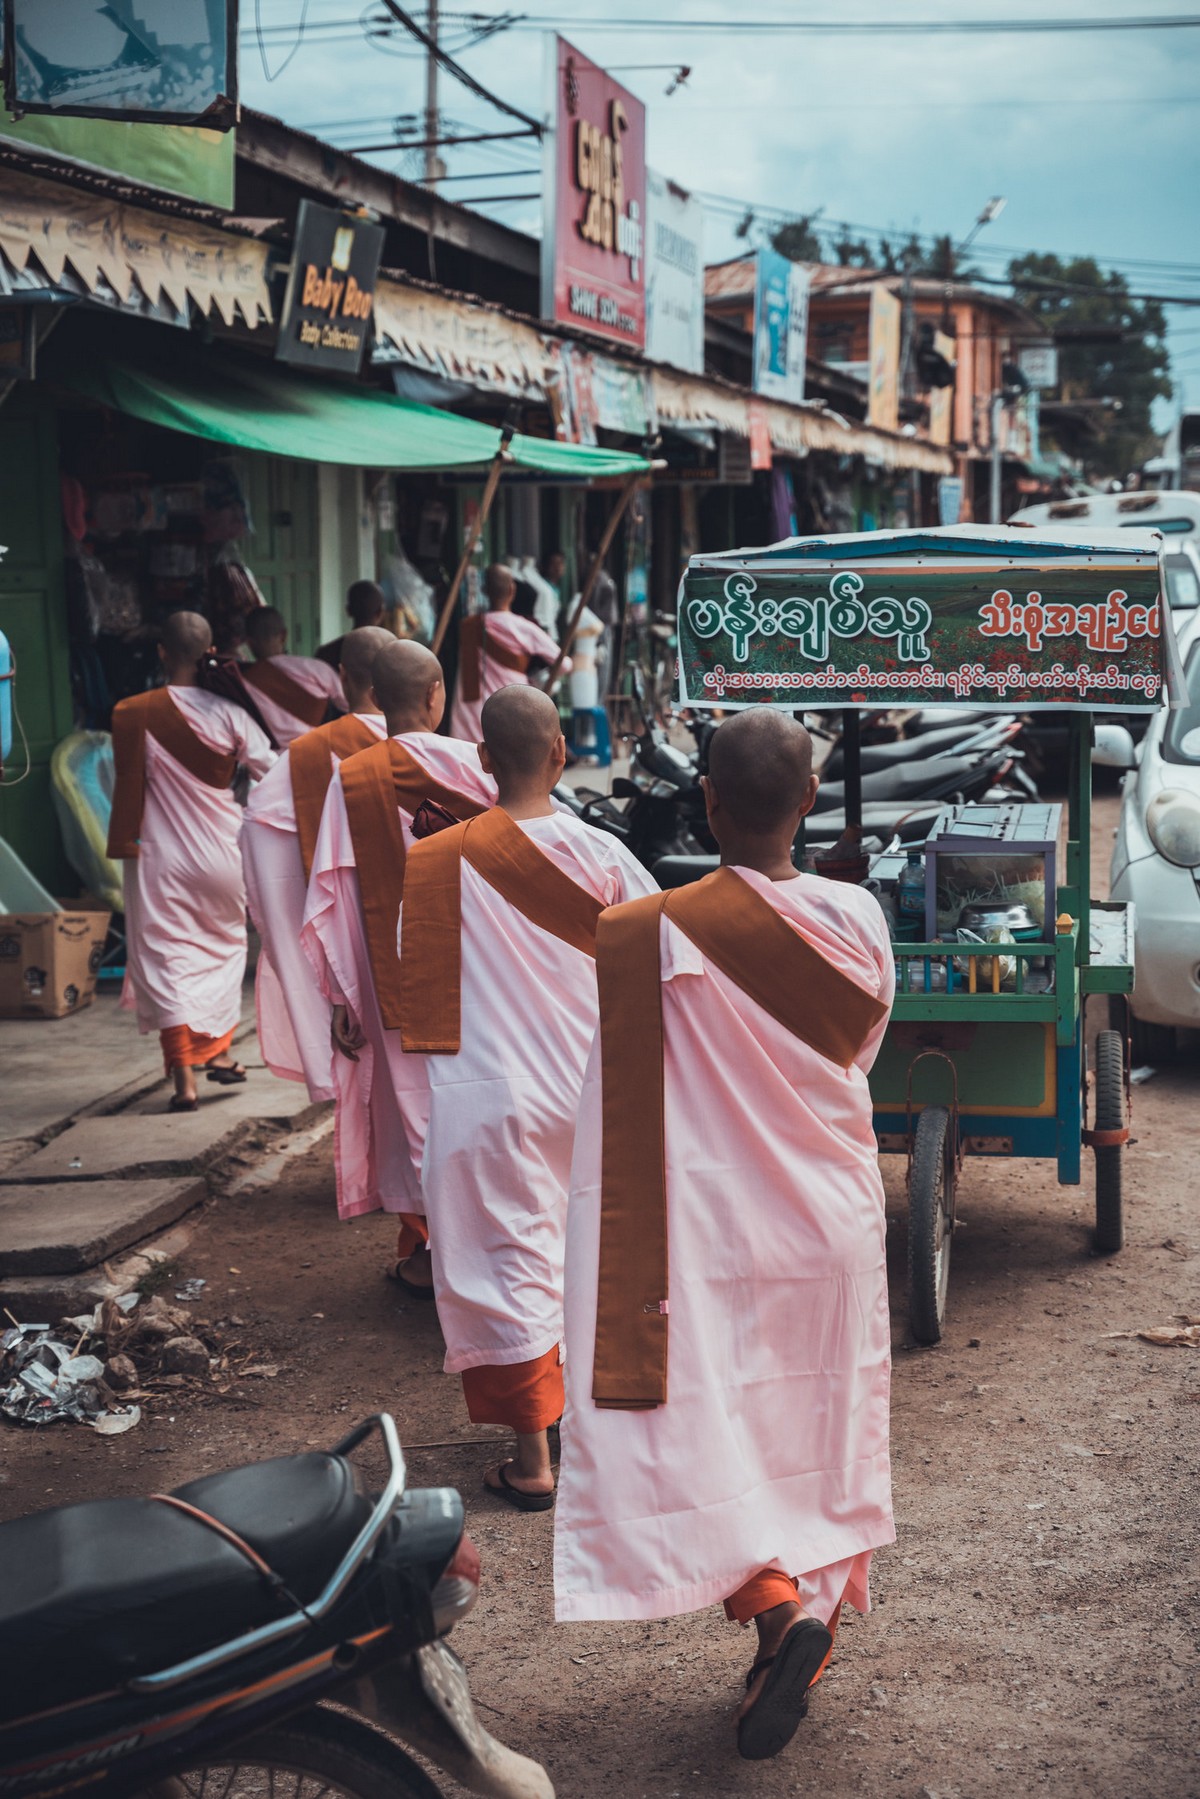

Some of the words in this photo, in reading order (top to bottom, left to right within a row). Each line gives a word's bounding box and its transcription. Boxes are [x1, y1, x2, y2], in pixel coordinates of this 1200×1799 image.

[302, 264, 344, 319] Baby
[342, 275, 372, 320] Boo
[687, 572, 932, 662] ပန်းချစ်သူ
